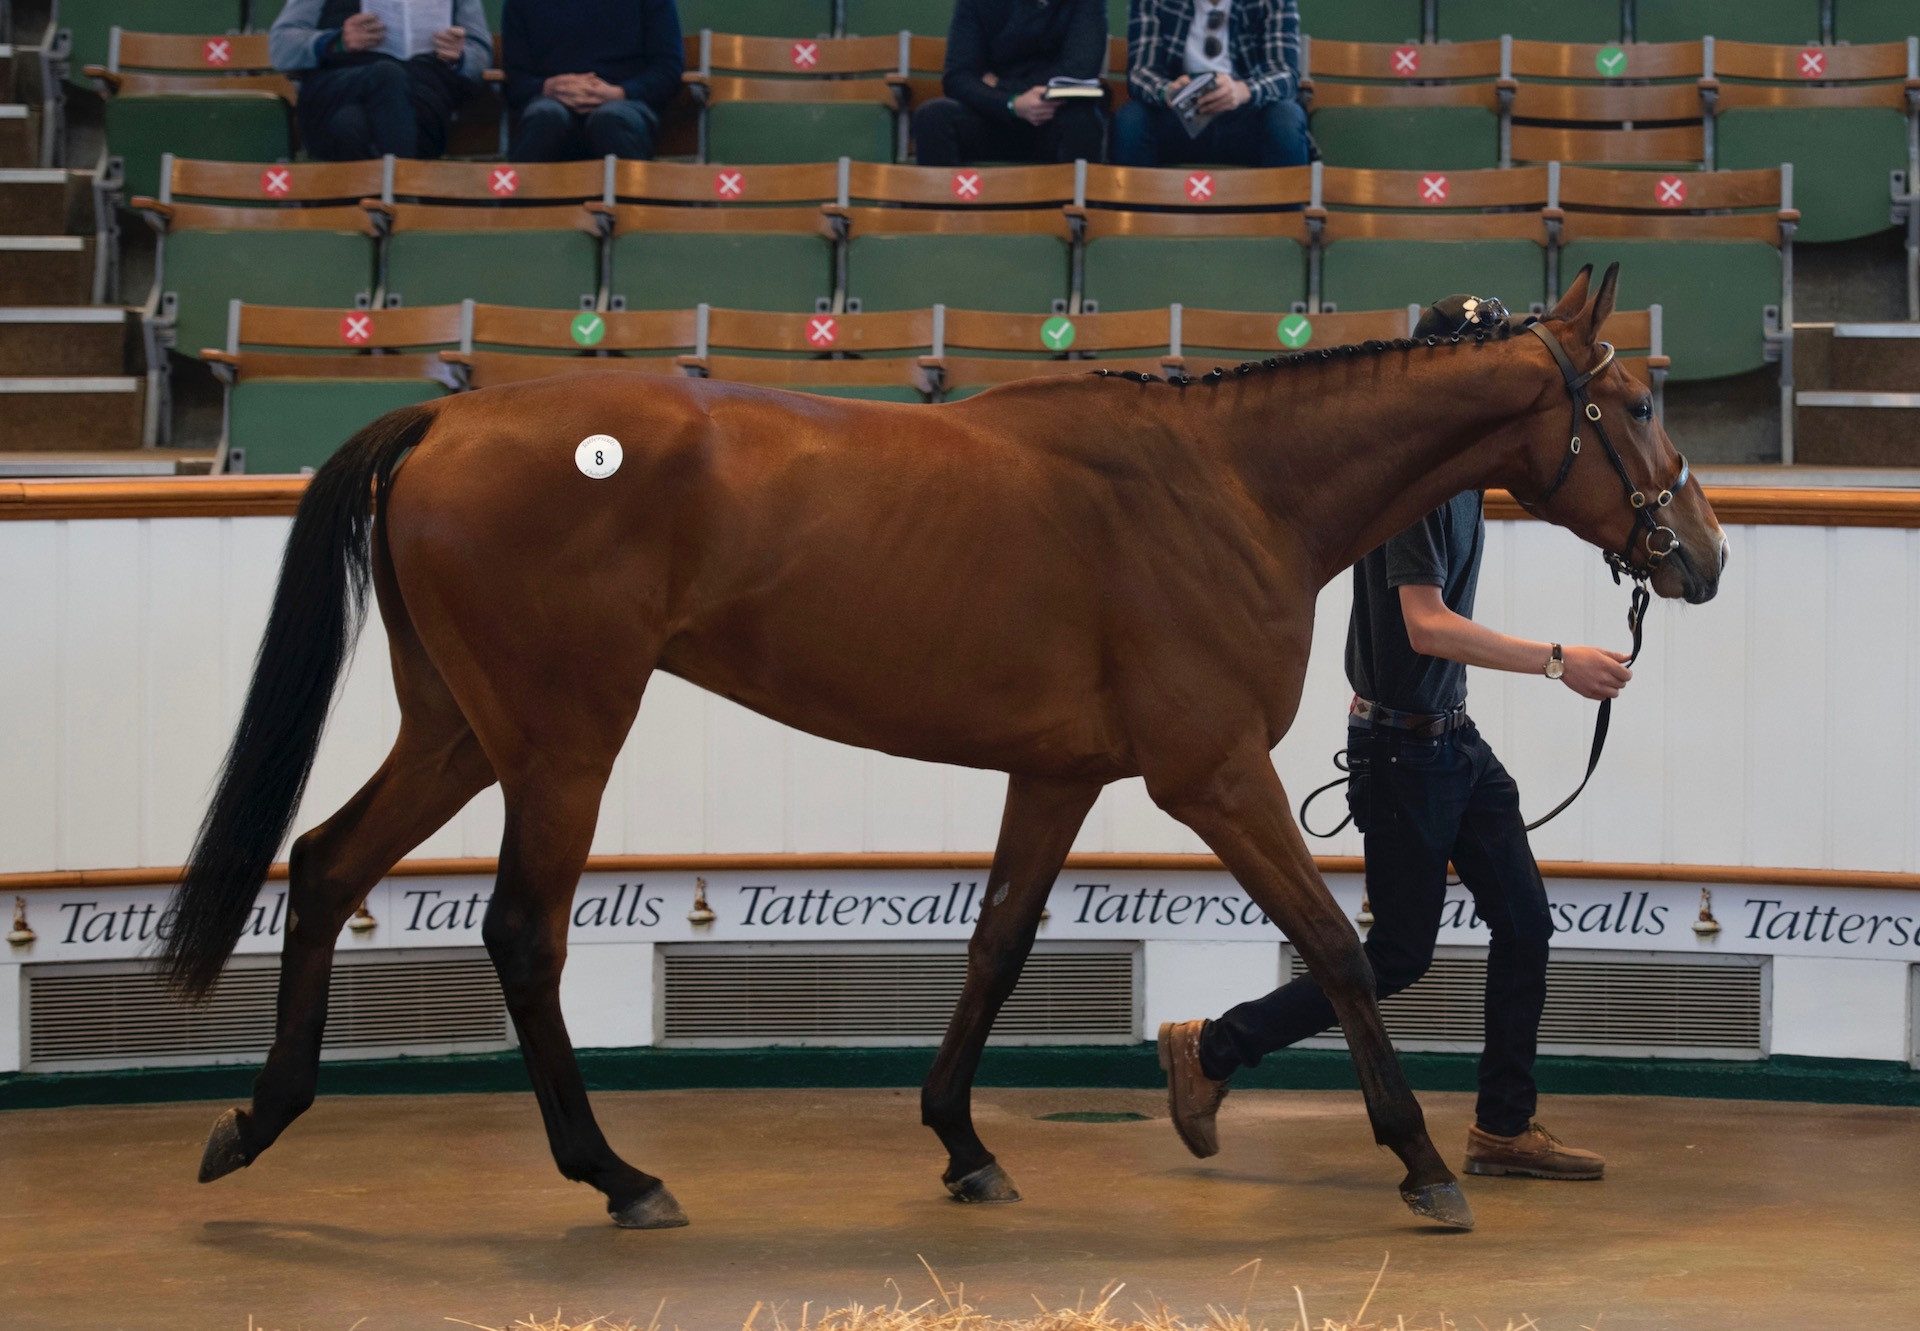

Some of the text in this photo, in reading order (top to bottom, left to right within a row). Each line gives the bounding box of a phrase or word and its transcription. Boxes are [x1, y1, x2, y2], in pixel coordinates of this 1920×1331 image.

[595, 450, 603, 465] 8
[60, 892, 287, 944] Tatteal
[404, 883, 665, 931] Tatalls
[1073, 884, 1270, 926] Tattersa
[1744, 898, 1920, 946] Tatters
